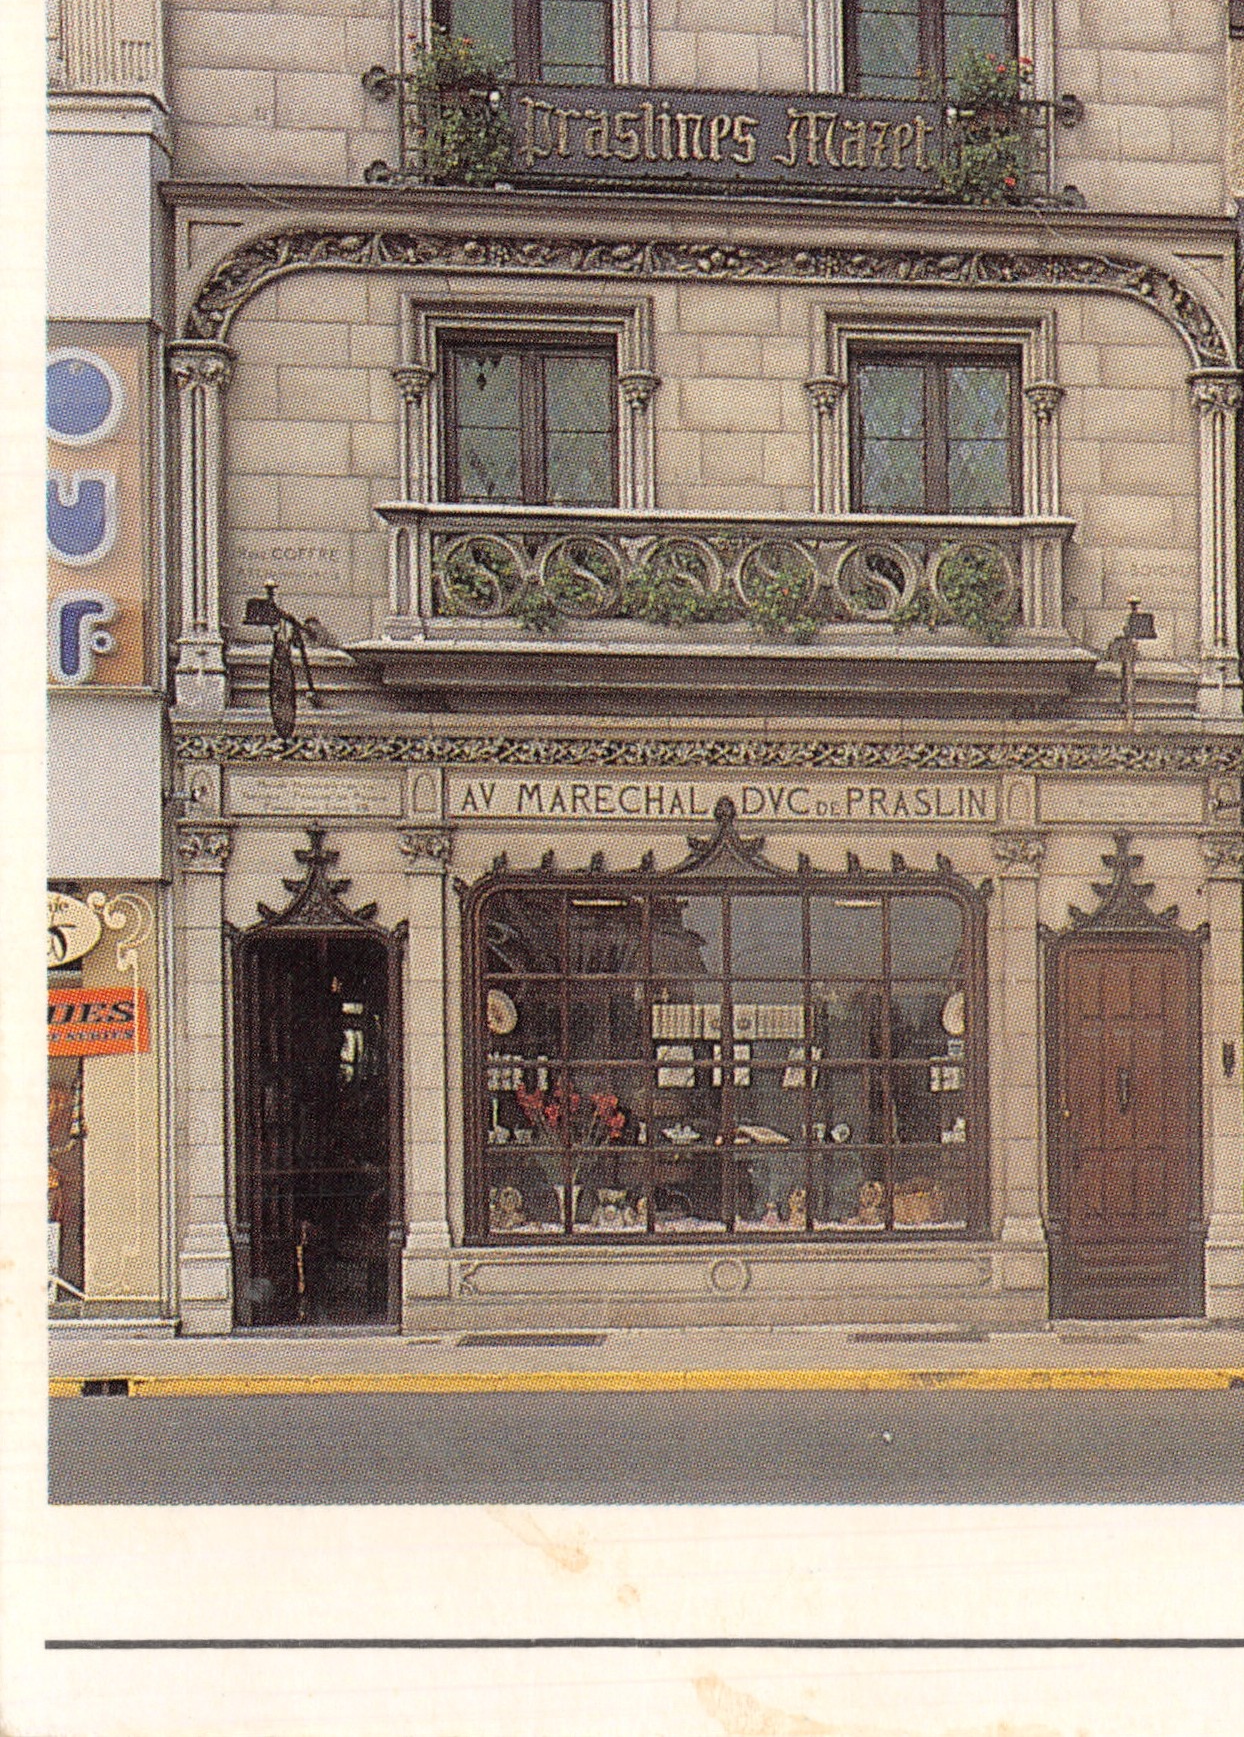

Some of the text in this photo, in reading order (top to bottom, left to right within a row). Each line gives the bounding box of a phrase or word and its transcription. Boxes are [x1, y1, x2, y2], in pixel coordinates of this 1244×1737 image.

[772, 107, 935, 172] Mazet
[460, 782, 497, 811] AV
[517, 782, 709, 817] MARECHAL
[846, 786, 988, 818] PRASLIN
